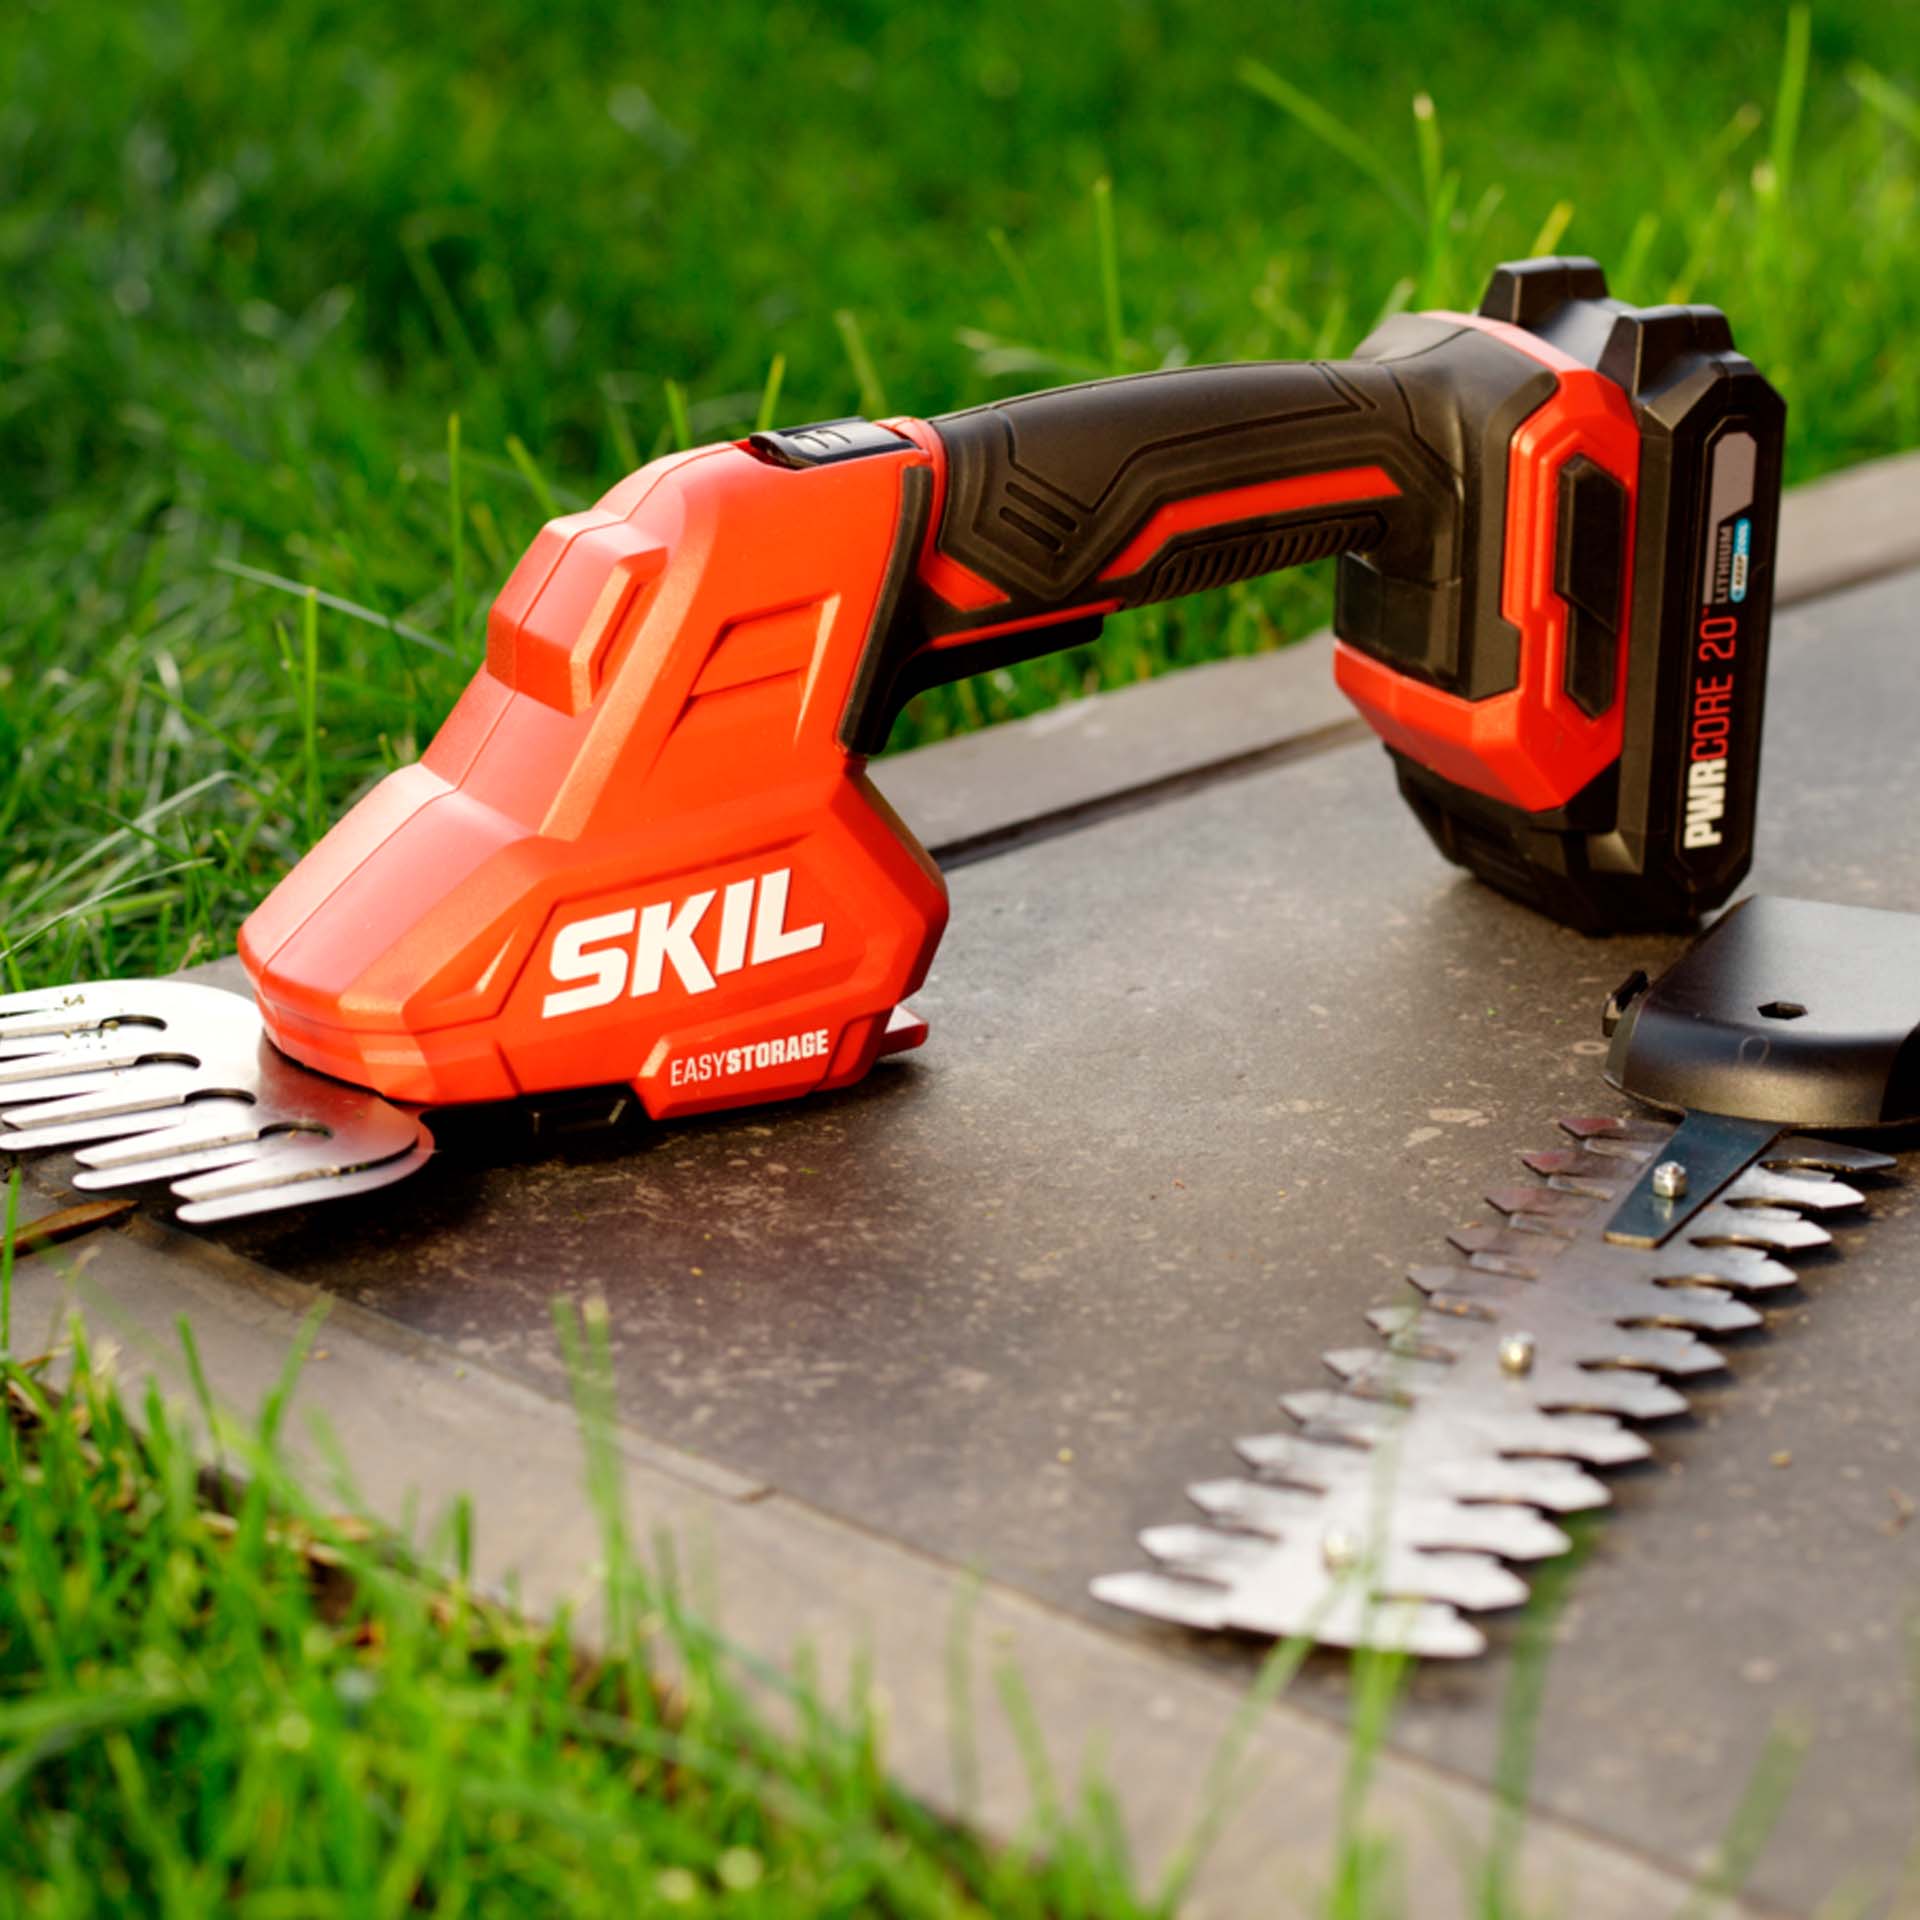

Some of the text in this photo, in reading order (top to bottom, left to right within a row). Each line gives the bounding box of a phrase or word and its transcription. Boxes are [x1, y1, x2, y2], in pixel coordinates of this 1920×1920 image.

[1714, 525, 1733, 604] LITHIUM
[1684, 673, 1733, 848] PWRCORE
[541, 867, 825, 1019] SKIL
[670, 1028, 830, 1087] EASYSTORAGE
